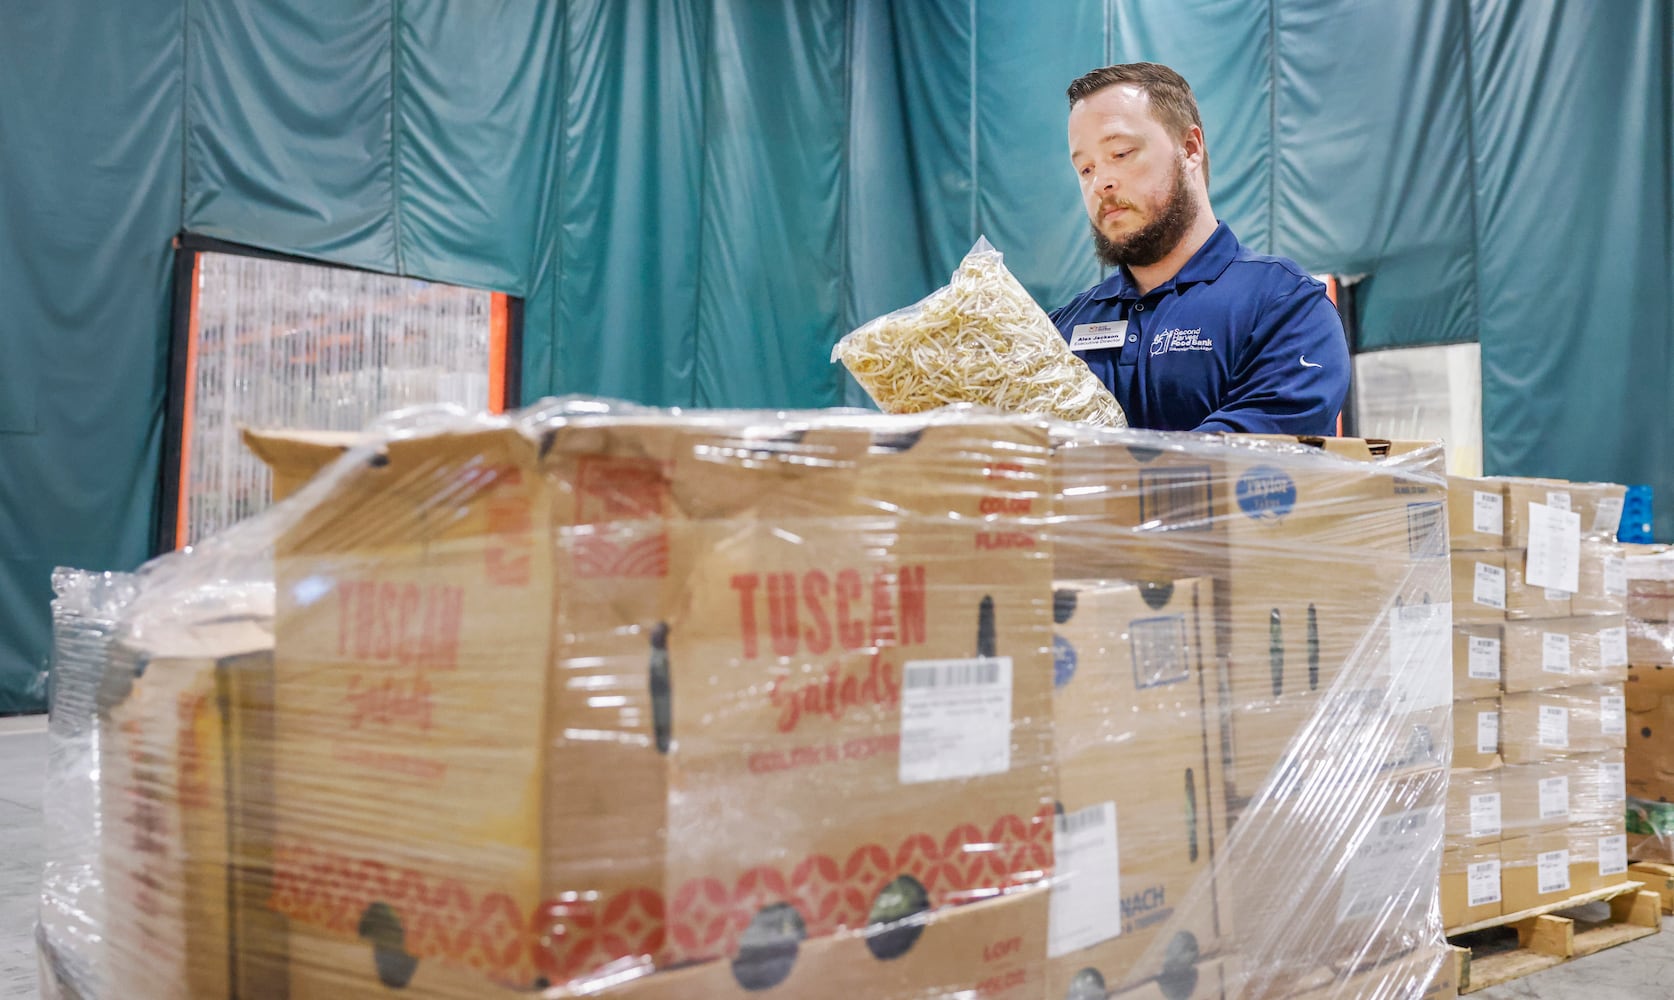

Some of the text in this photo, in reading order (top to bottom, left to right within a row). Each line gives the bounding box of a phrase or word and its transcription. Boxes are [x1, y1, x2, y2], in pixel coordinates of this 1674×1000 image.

[1170, 337, 1213, 347] Food Bank
[1174, 327, 1201, 335] Second
[338, 581, 464, 670] TUSCAN
[730, 565, 926, 659] TUSCAN
[768, 654, 899, 735] Salads
